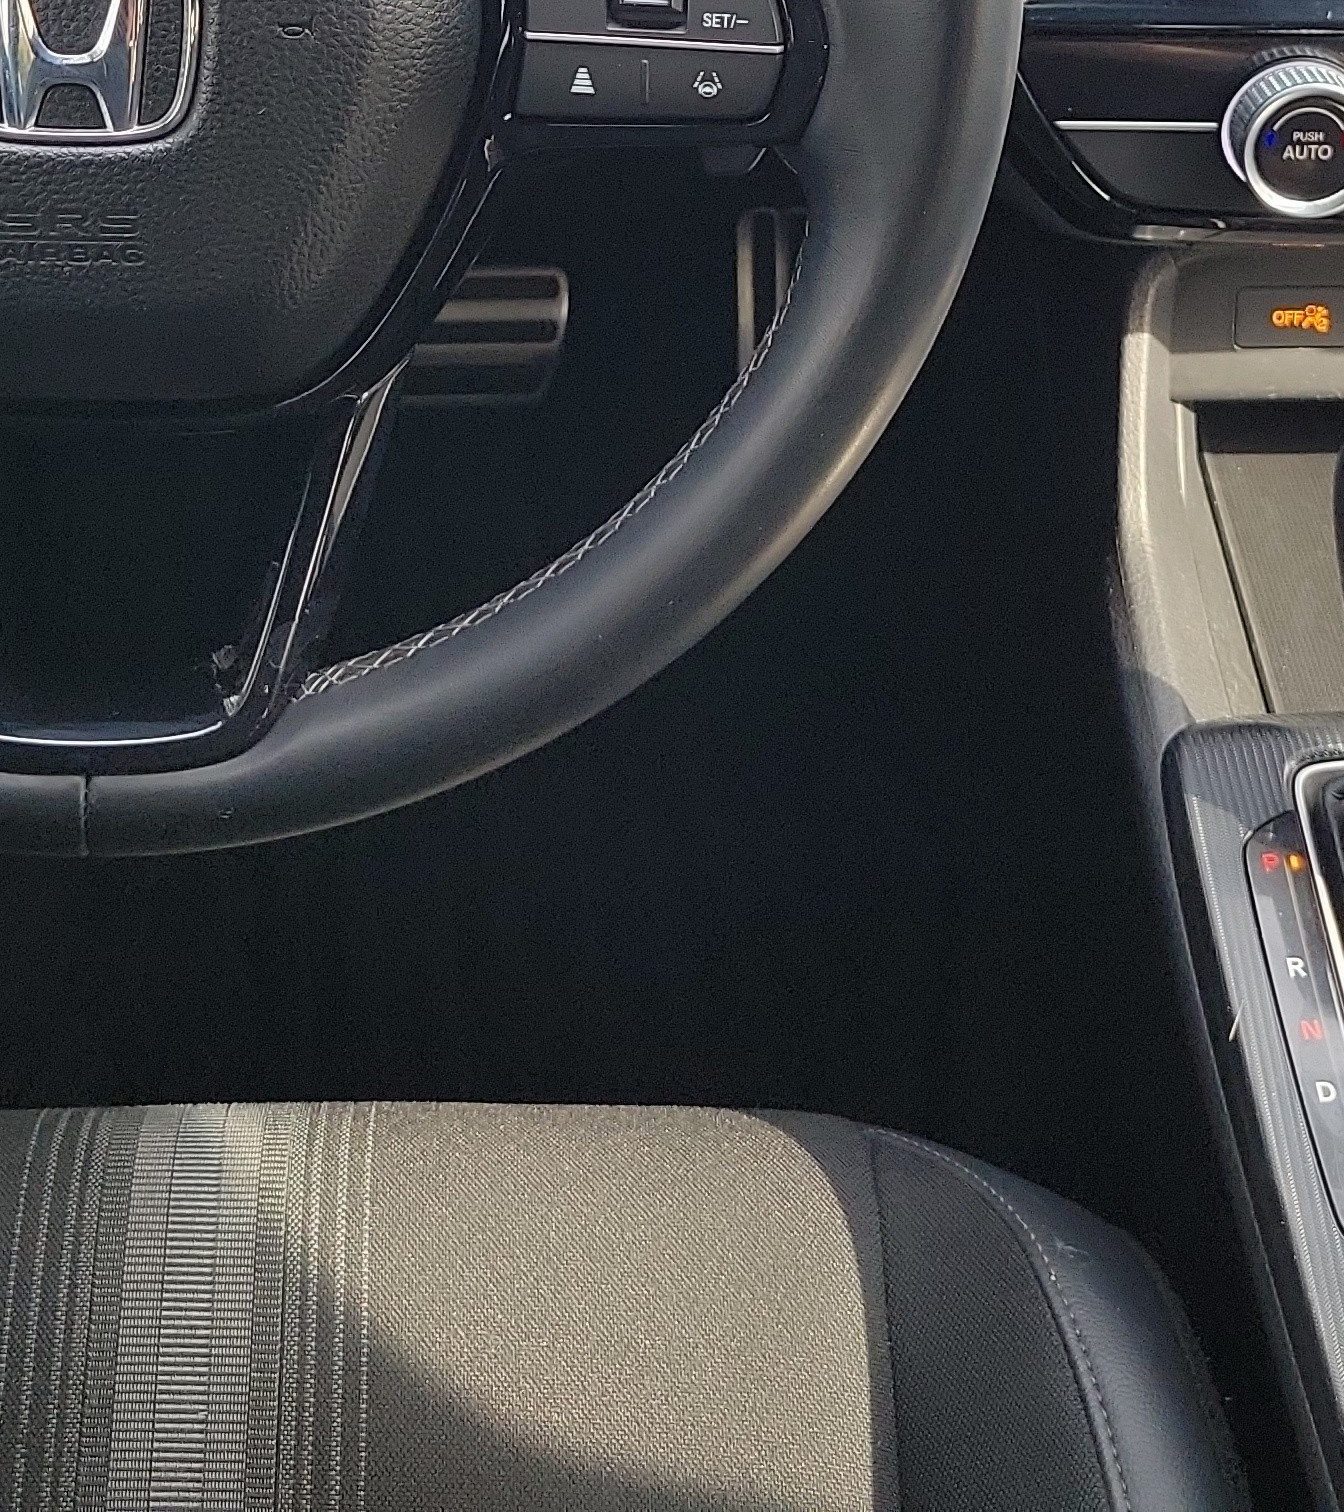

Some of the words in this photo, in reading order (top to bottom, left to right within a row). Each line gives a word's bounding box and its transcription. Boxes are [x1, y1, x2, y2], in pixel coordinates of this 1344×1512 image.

[1292, 130, 1325, 142] PUSH
[1281, 144, 1335, 162] AUTO
[1271, 310, 1305, 327] OFF
[1261, 853, 1279, 871] P
[1286, 956, 1308, 978] R
[1300, 1020, 1323, 1040] N
[1316, 1081, 1337, 1103] D
